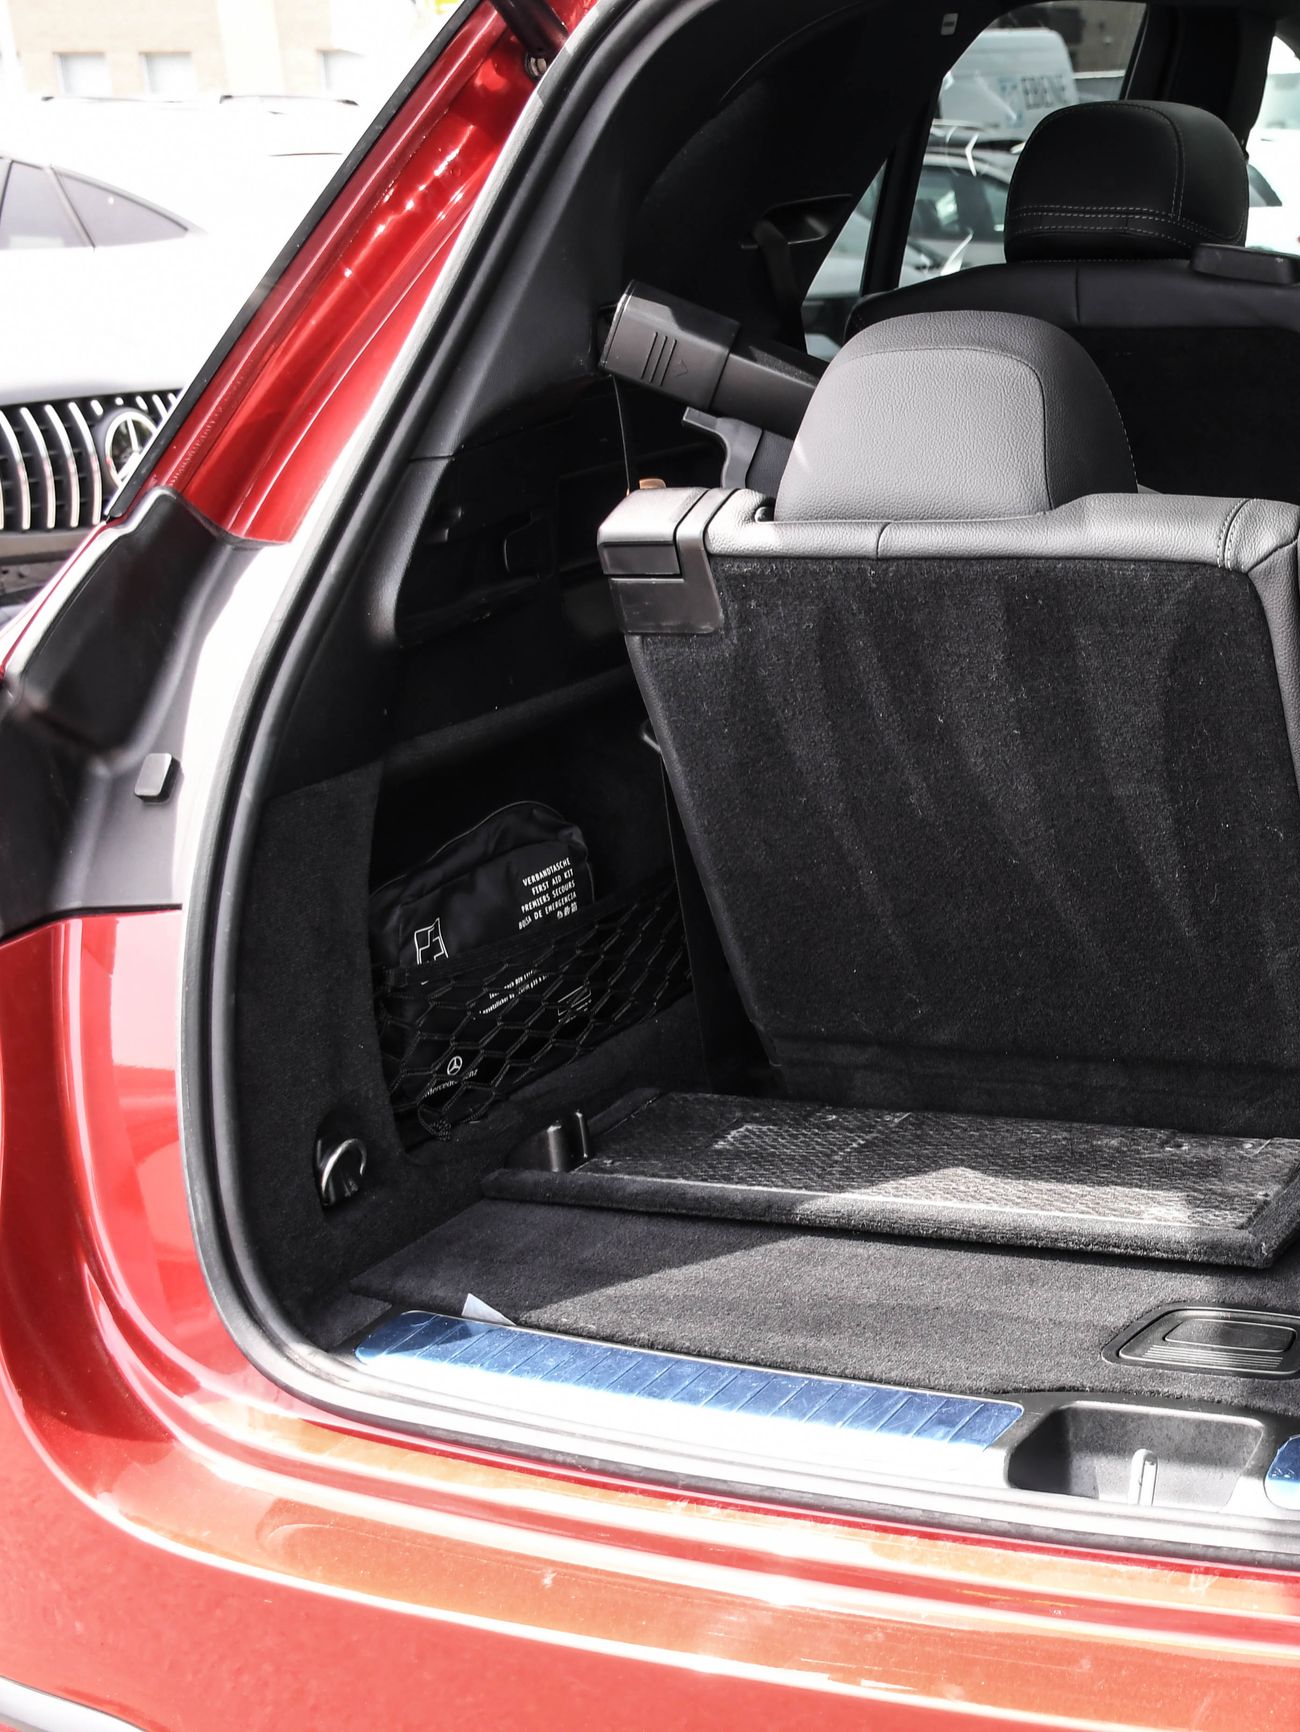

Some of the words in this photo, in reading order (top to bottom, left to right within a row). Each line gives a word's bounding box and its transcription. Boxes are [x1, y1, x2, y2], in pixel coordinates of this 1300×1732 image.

[522, 857, 571, 887] VERBANDTASCHE
[531, 881, 549, 896] FIRST
[552, 875, 562, 886] AID
[563, 868, 574, 879] KIT
[518, 915, 532, 930] BOLSA
[533, 910, 543, 920] DE
[544, 891, 577, 915] EMERGENCIA
[521, 893, 551, 913] PREMIERS
[552, 880, 576, 898] SECOURS
